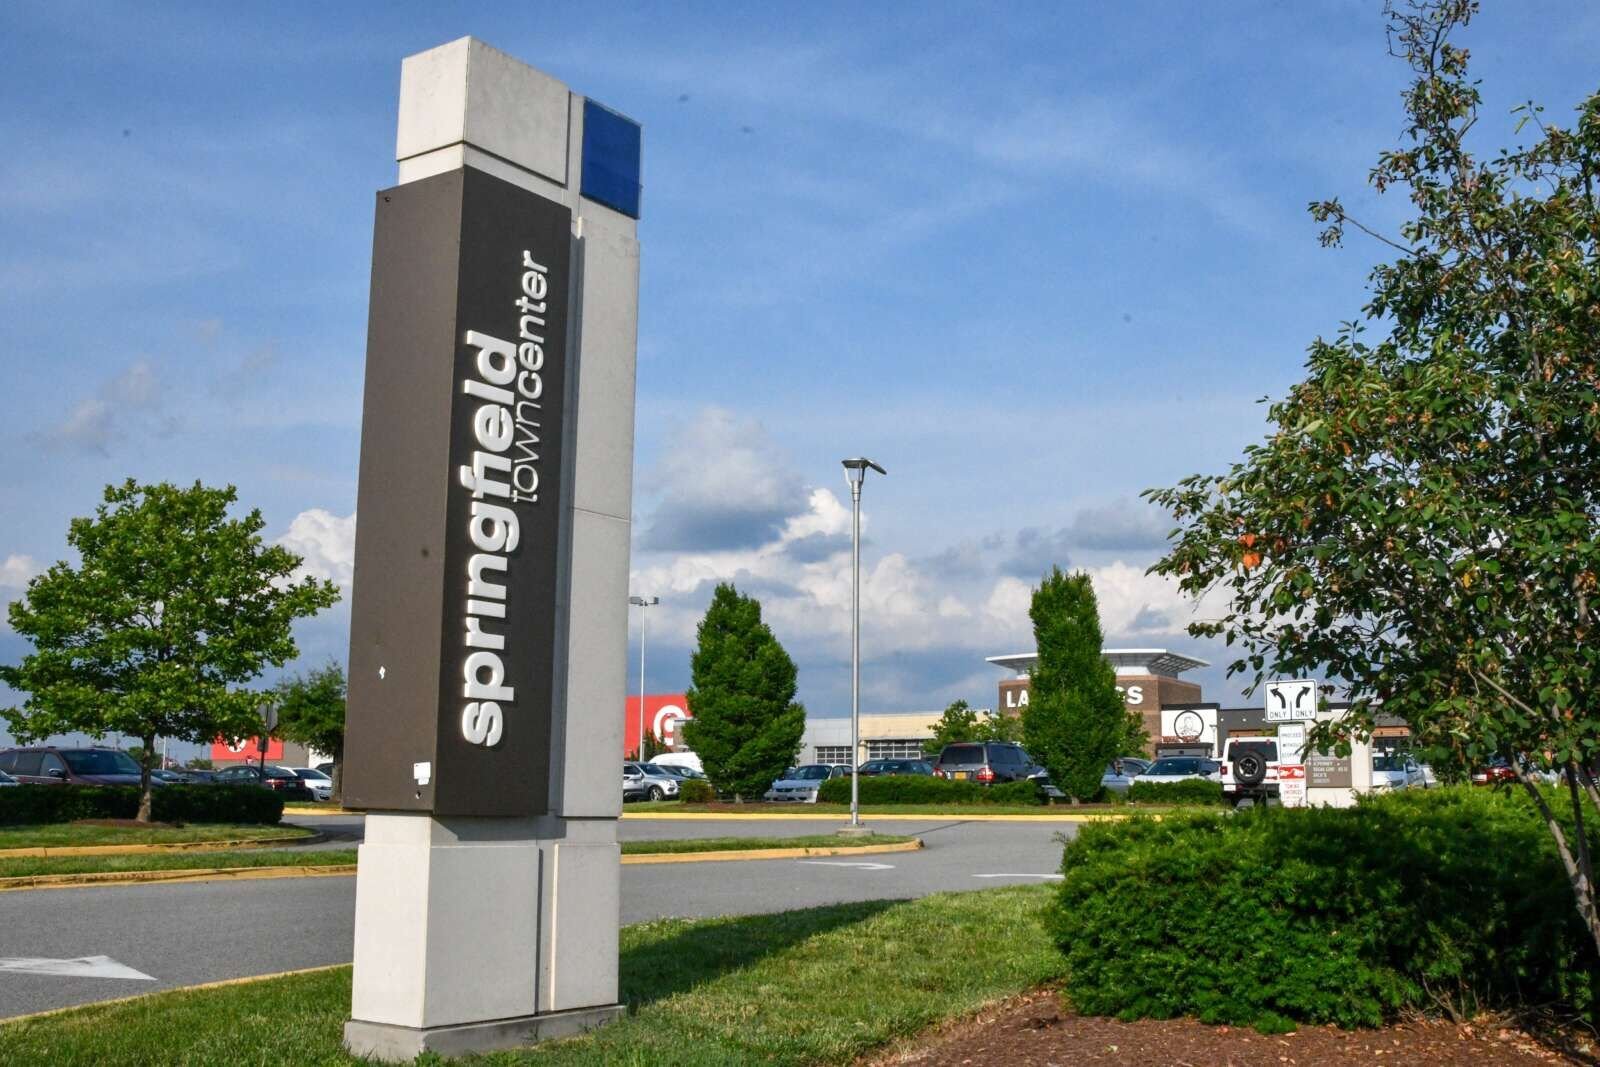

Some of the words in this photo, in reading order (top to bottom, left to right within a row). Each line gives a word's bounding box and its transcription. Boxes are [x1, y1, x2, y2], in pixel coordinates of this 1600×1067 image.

[459, 329, 520, 747] springfield
[1269, 711, 1287, 719] ONLY
[1295, 710, 1313, 718] ONLY
